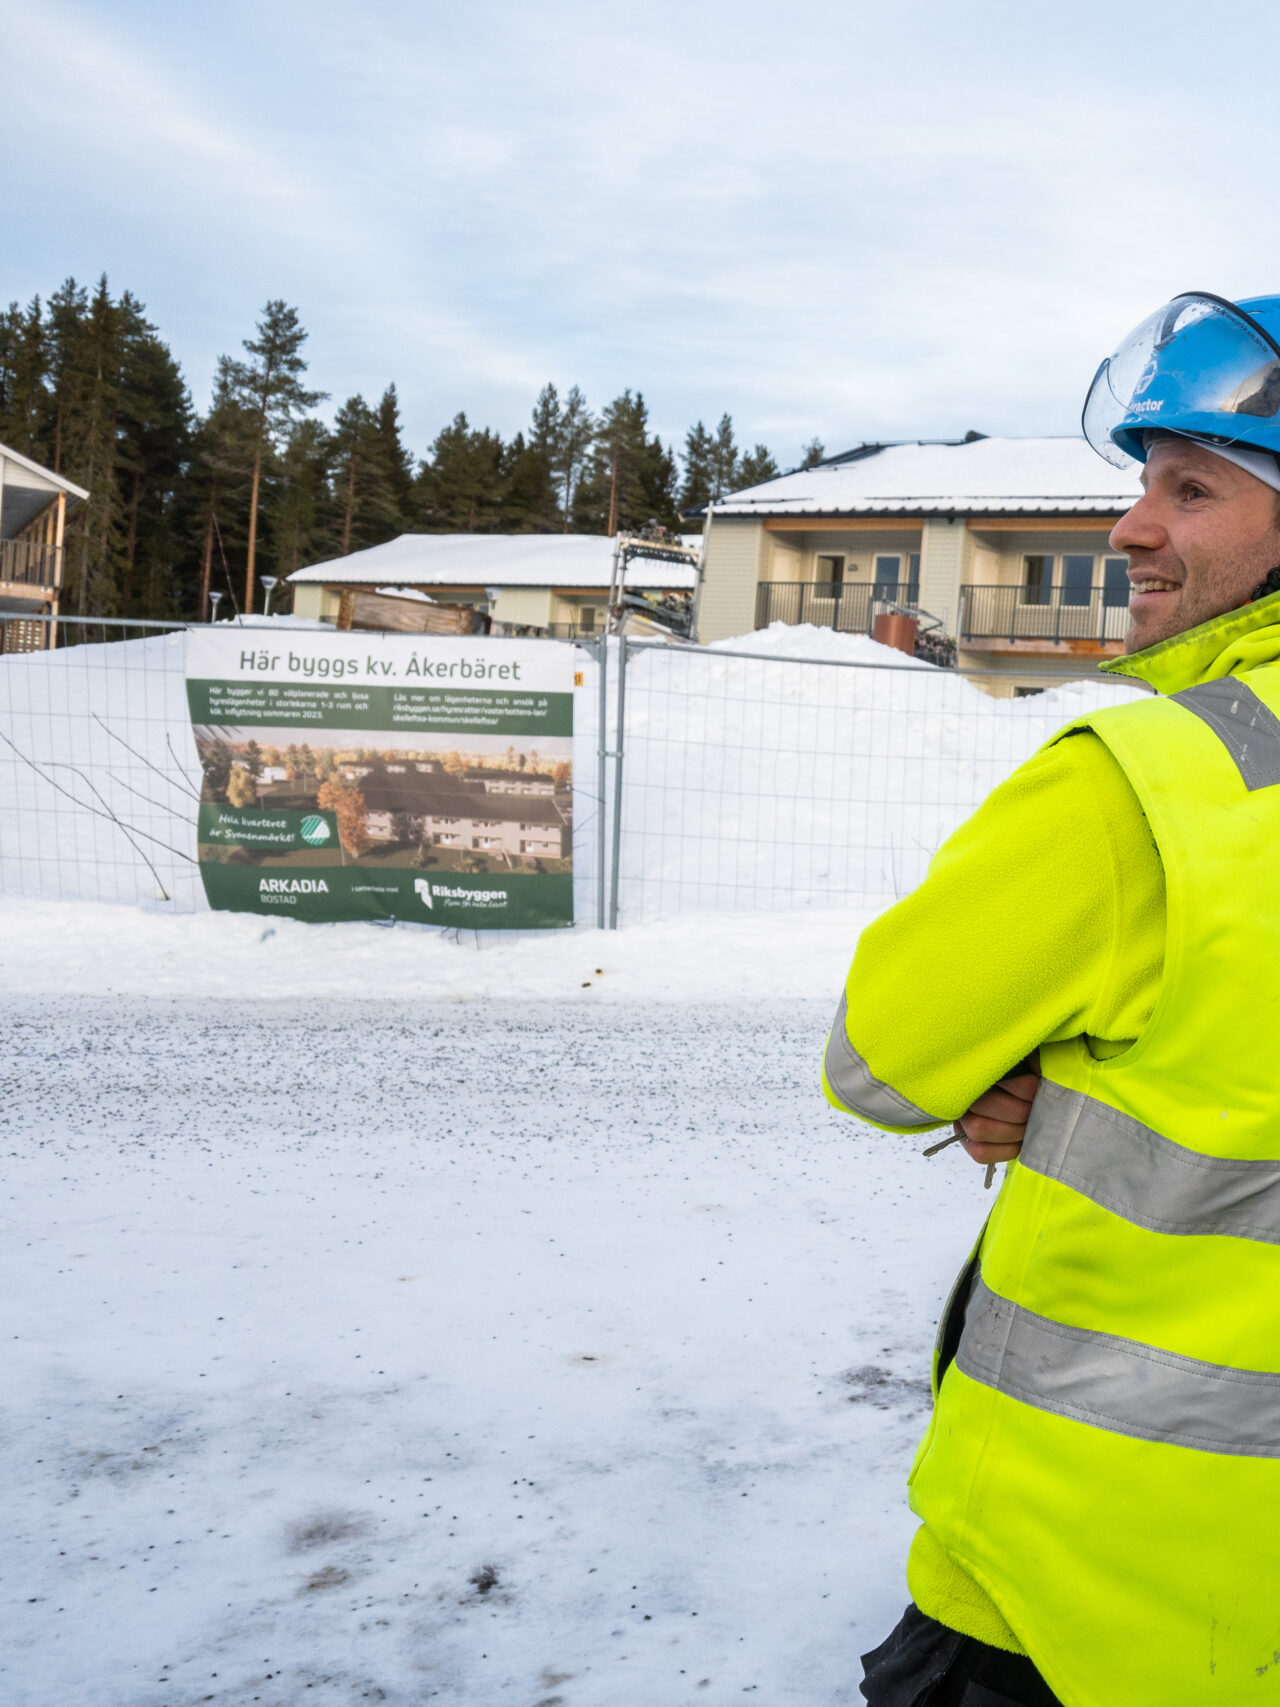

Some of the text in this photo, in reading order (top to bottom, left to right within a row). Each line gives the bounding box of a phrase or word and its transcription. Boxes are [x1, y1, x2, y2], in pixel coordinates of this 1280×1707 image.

[240, 650, 521, 680] Här byggs kv. Åkerbäret
[209, 687, 223, 695] Här
[226, 687, 251, 698] bygger
[256, 688, 264, 696] vi
[333, 691, 348, 699] och
[410, 694, 425, 703] mer
[428, 695, 441, 703] om
[495, 697, 509, 705] och
[321, 701, 334, 709] 1-3
[336, 702, 351, 710] rum
[354, 702, 369, 710] och
[224, 707, 262, 718] Inflyttning
[262, 710, 300, 718] sommaren
[259, 878, 329, 893] ARKADIA
[432, 885, 508, 901] Riksbyggen
[260, 894, 297, 904] BOSTAD
